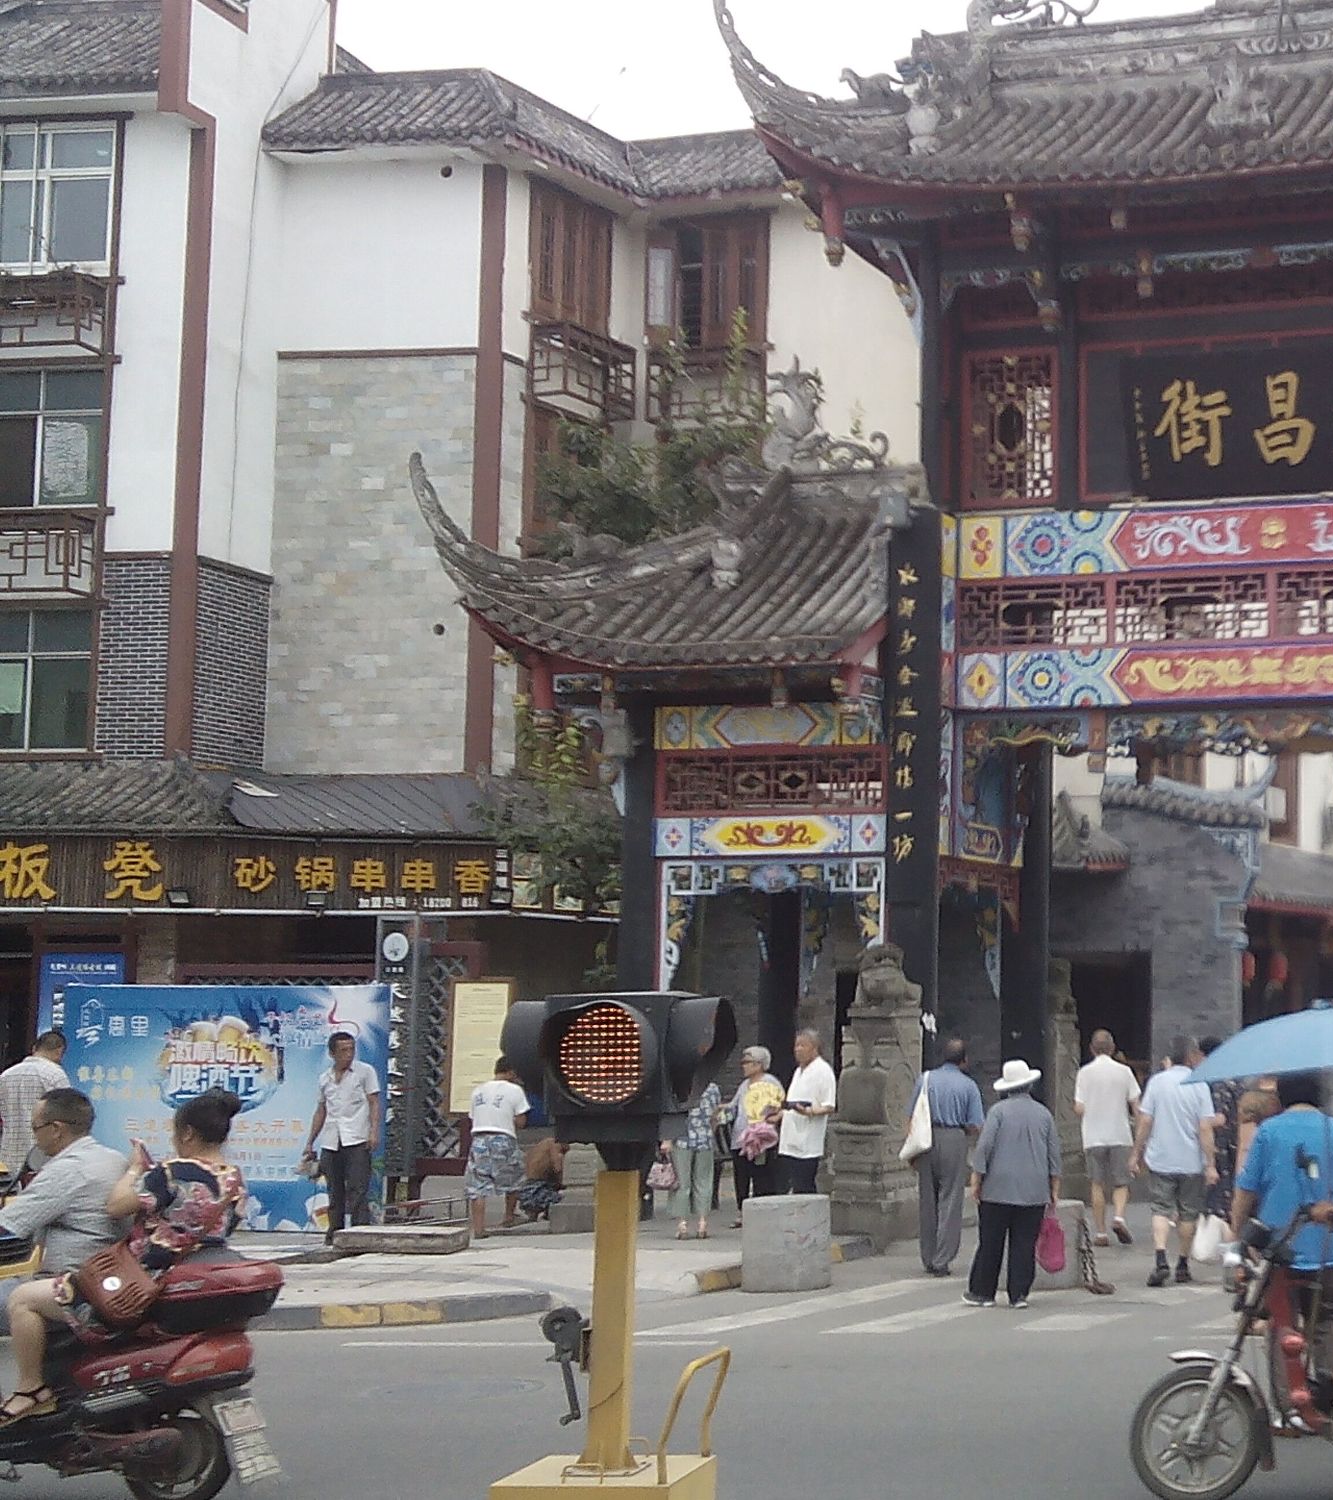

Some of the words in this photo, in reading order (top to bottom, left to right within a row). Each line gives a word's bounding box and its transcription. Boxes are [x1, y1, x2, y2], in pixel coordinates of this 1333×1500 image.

[0, 840, 164, 901] 板凳
[234, 854, 492, 894] 砂锅串串香
[168, 1064, 261, 1095] 啤酒节
